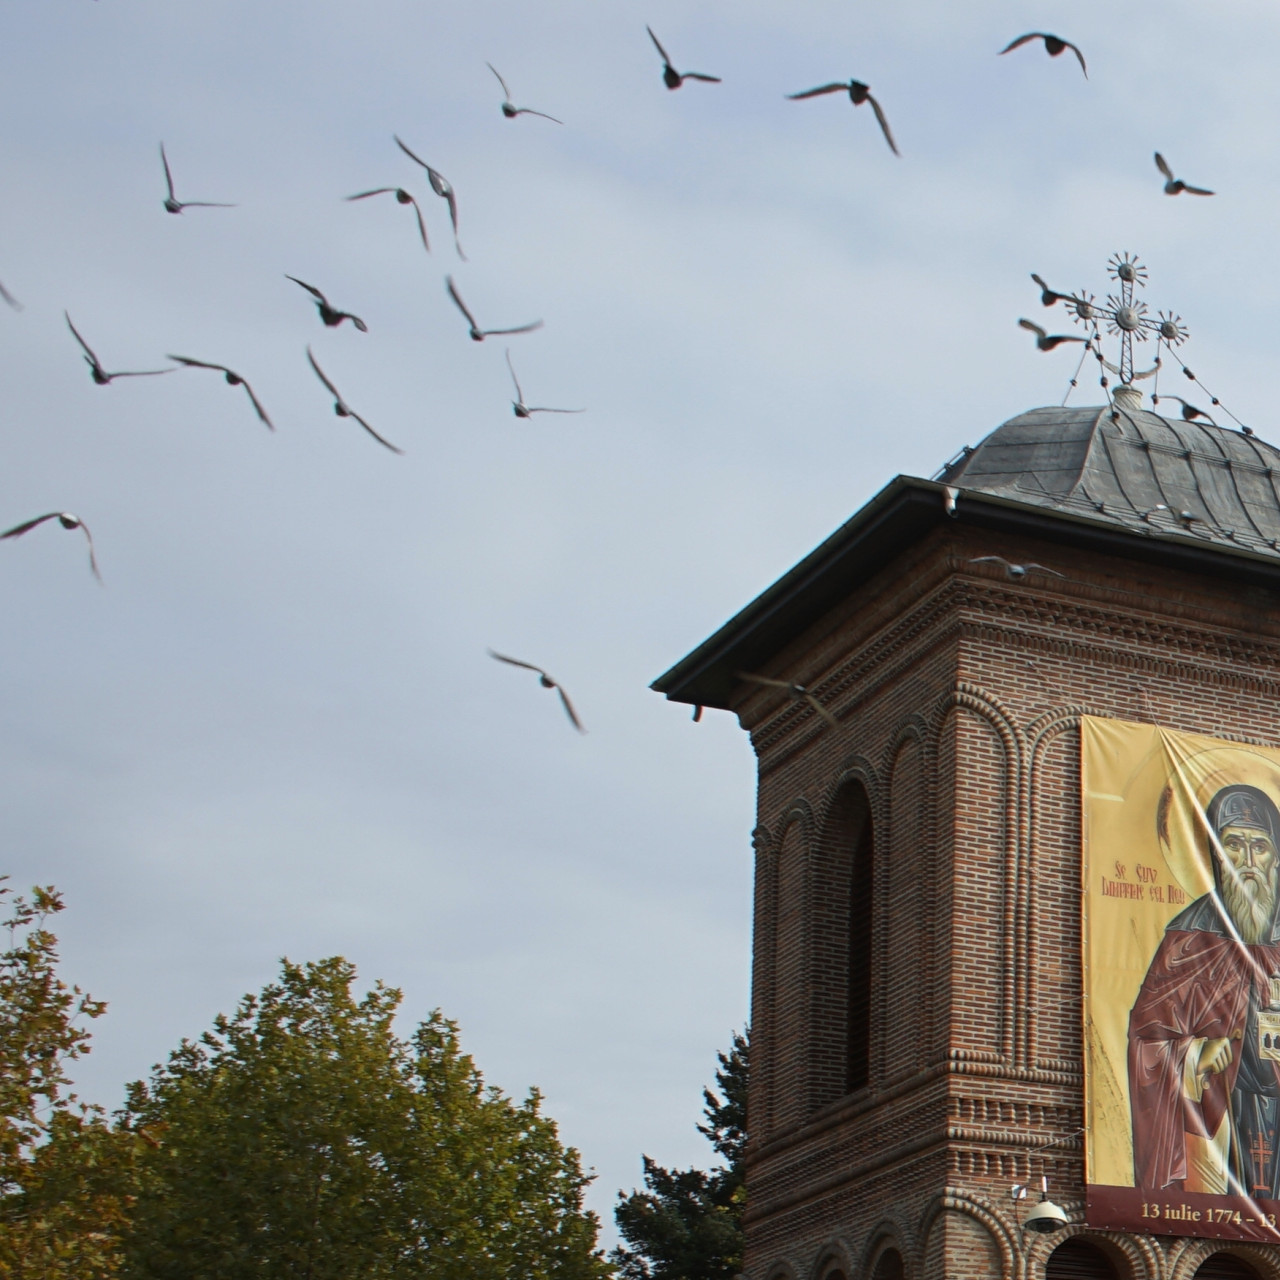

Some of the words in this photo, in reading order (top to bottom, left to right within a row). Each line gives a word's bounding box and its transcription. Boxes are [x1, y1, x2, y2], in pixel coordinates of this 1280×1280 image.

[1141, 1203, 1160, 1218] 13
[1165, 1204, 1201, 1221] iulie
[1206, 1208, 1242, 1225] 1774
[1260, 1213, 1276, 1228] 13
